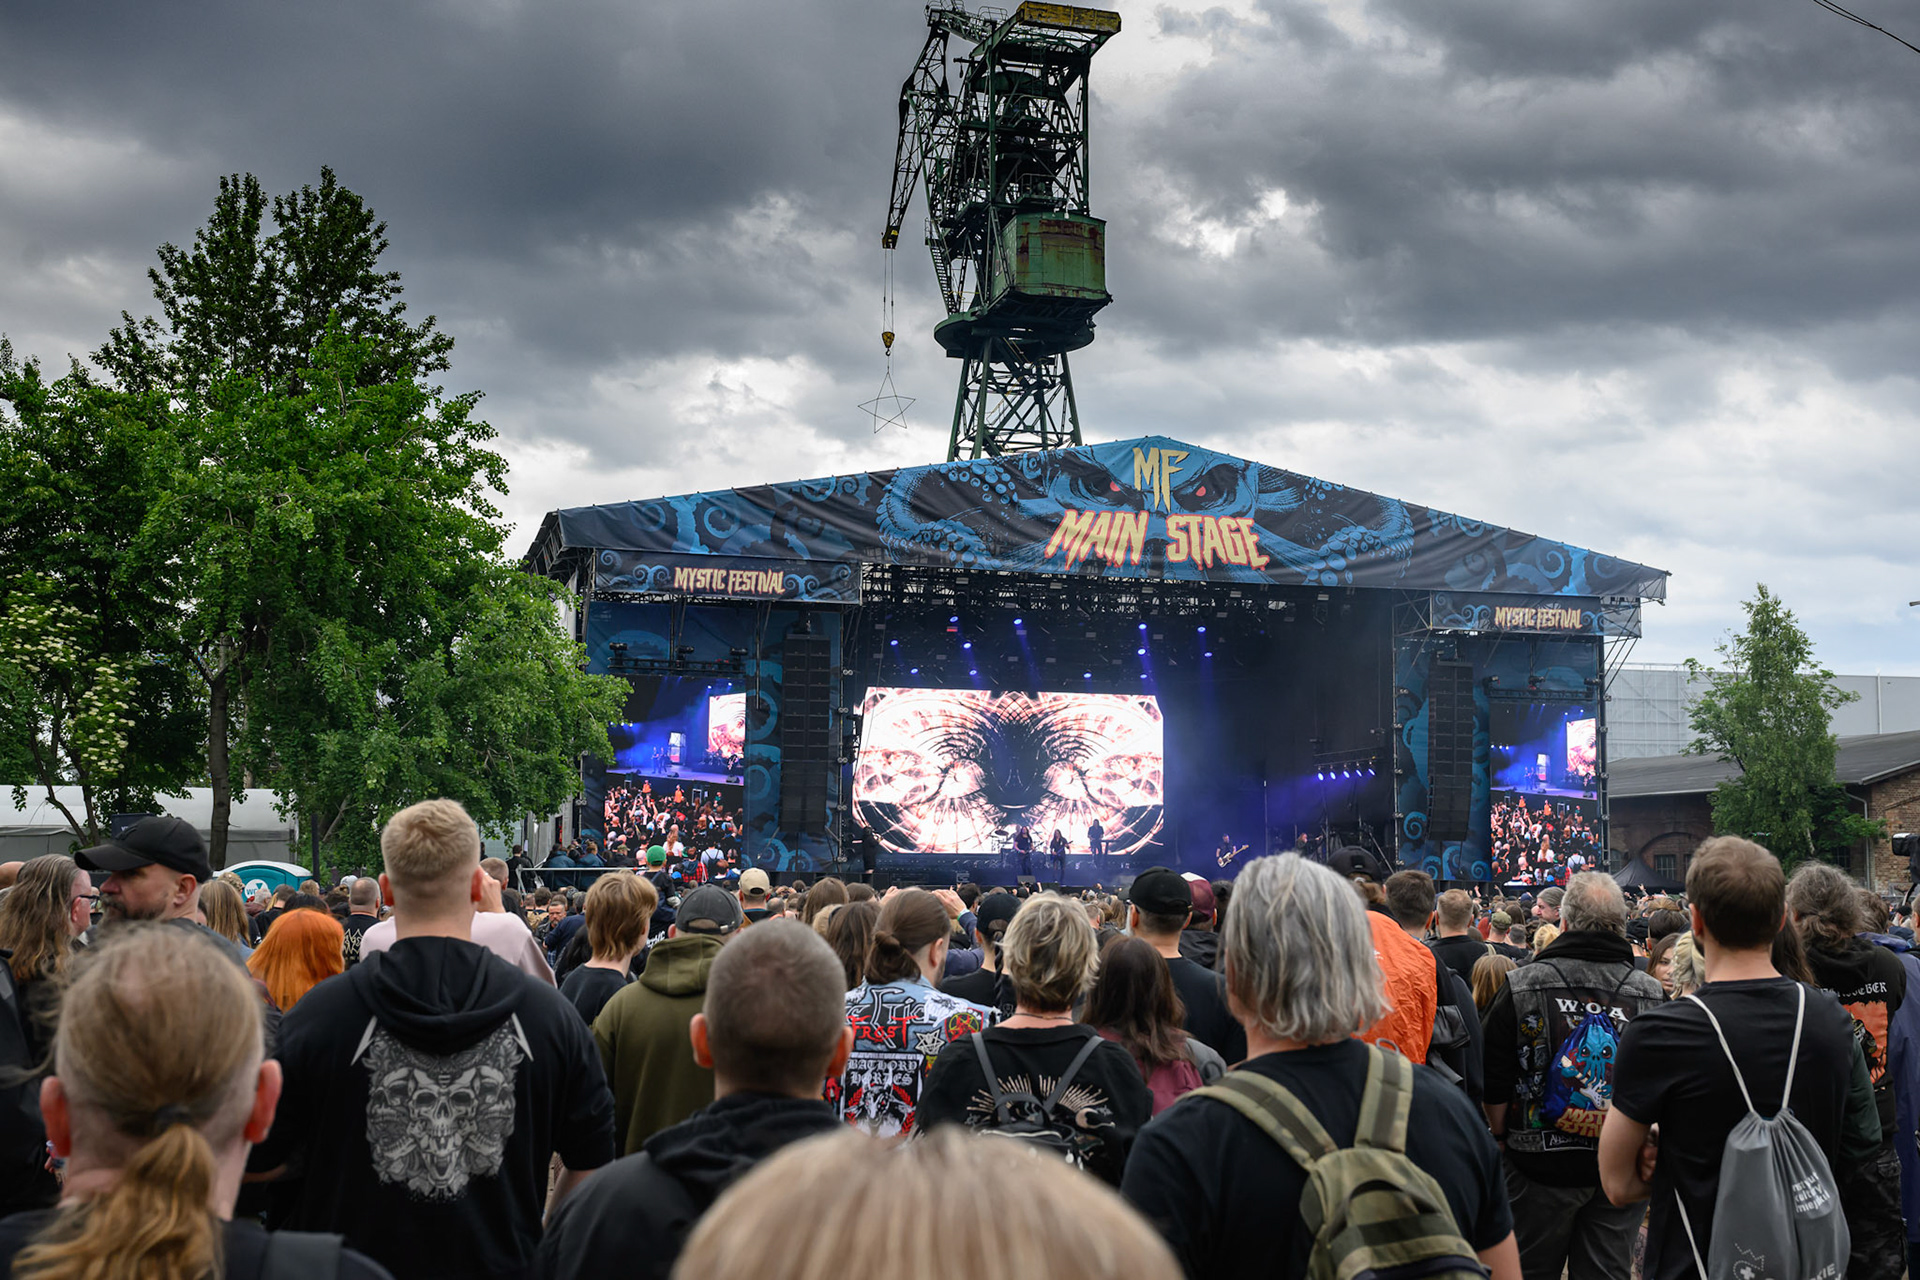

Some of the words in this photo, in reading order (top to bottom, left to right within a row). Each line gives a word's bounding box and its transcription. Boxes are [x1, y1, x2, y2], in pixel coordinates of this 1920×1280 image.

[1132, 447, 1190, 513] MF
[1045, 509, 1149, 570] MAIN
[1165, 513, 1270, 570] STAGE
[674, 566, 727, 593] MYSTIC
[727, 568, 786, 595] FESTIVAL
[1494, 606, 1535, 630] MYSTIC
[1536, 607, 1583, 631] FESTIVAL
